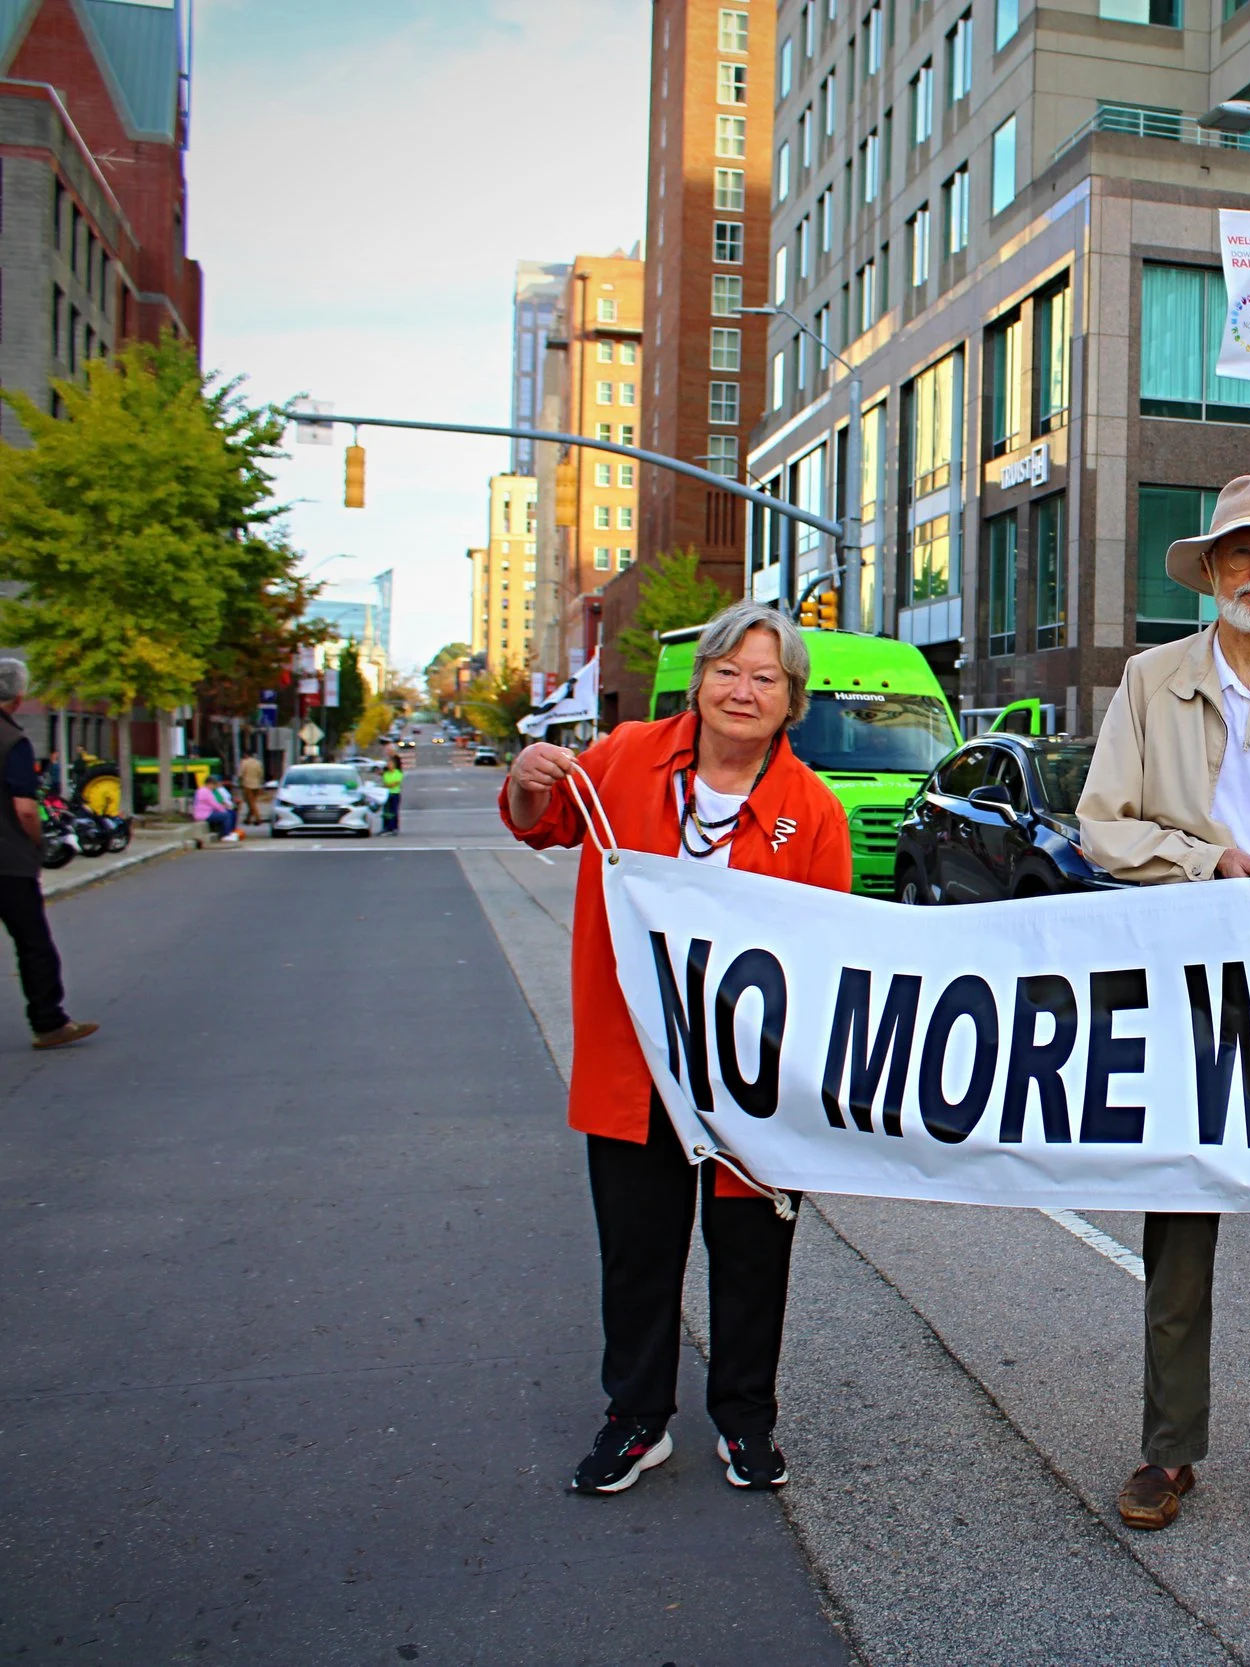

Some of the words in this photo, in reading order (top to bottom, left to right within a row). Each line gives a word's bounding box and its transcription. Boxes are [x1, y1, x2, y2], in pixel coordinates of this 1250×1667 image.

[1000, 456, 1031, 490] TRUIST
[834, 692, 886, 702] Humana
[649, 930, 788, 1119] NO
[822, 966, 1147, 1144] MORE
